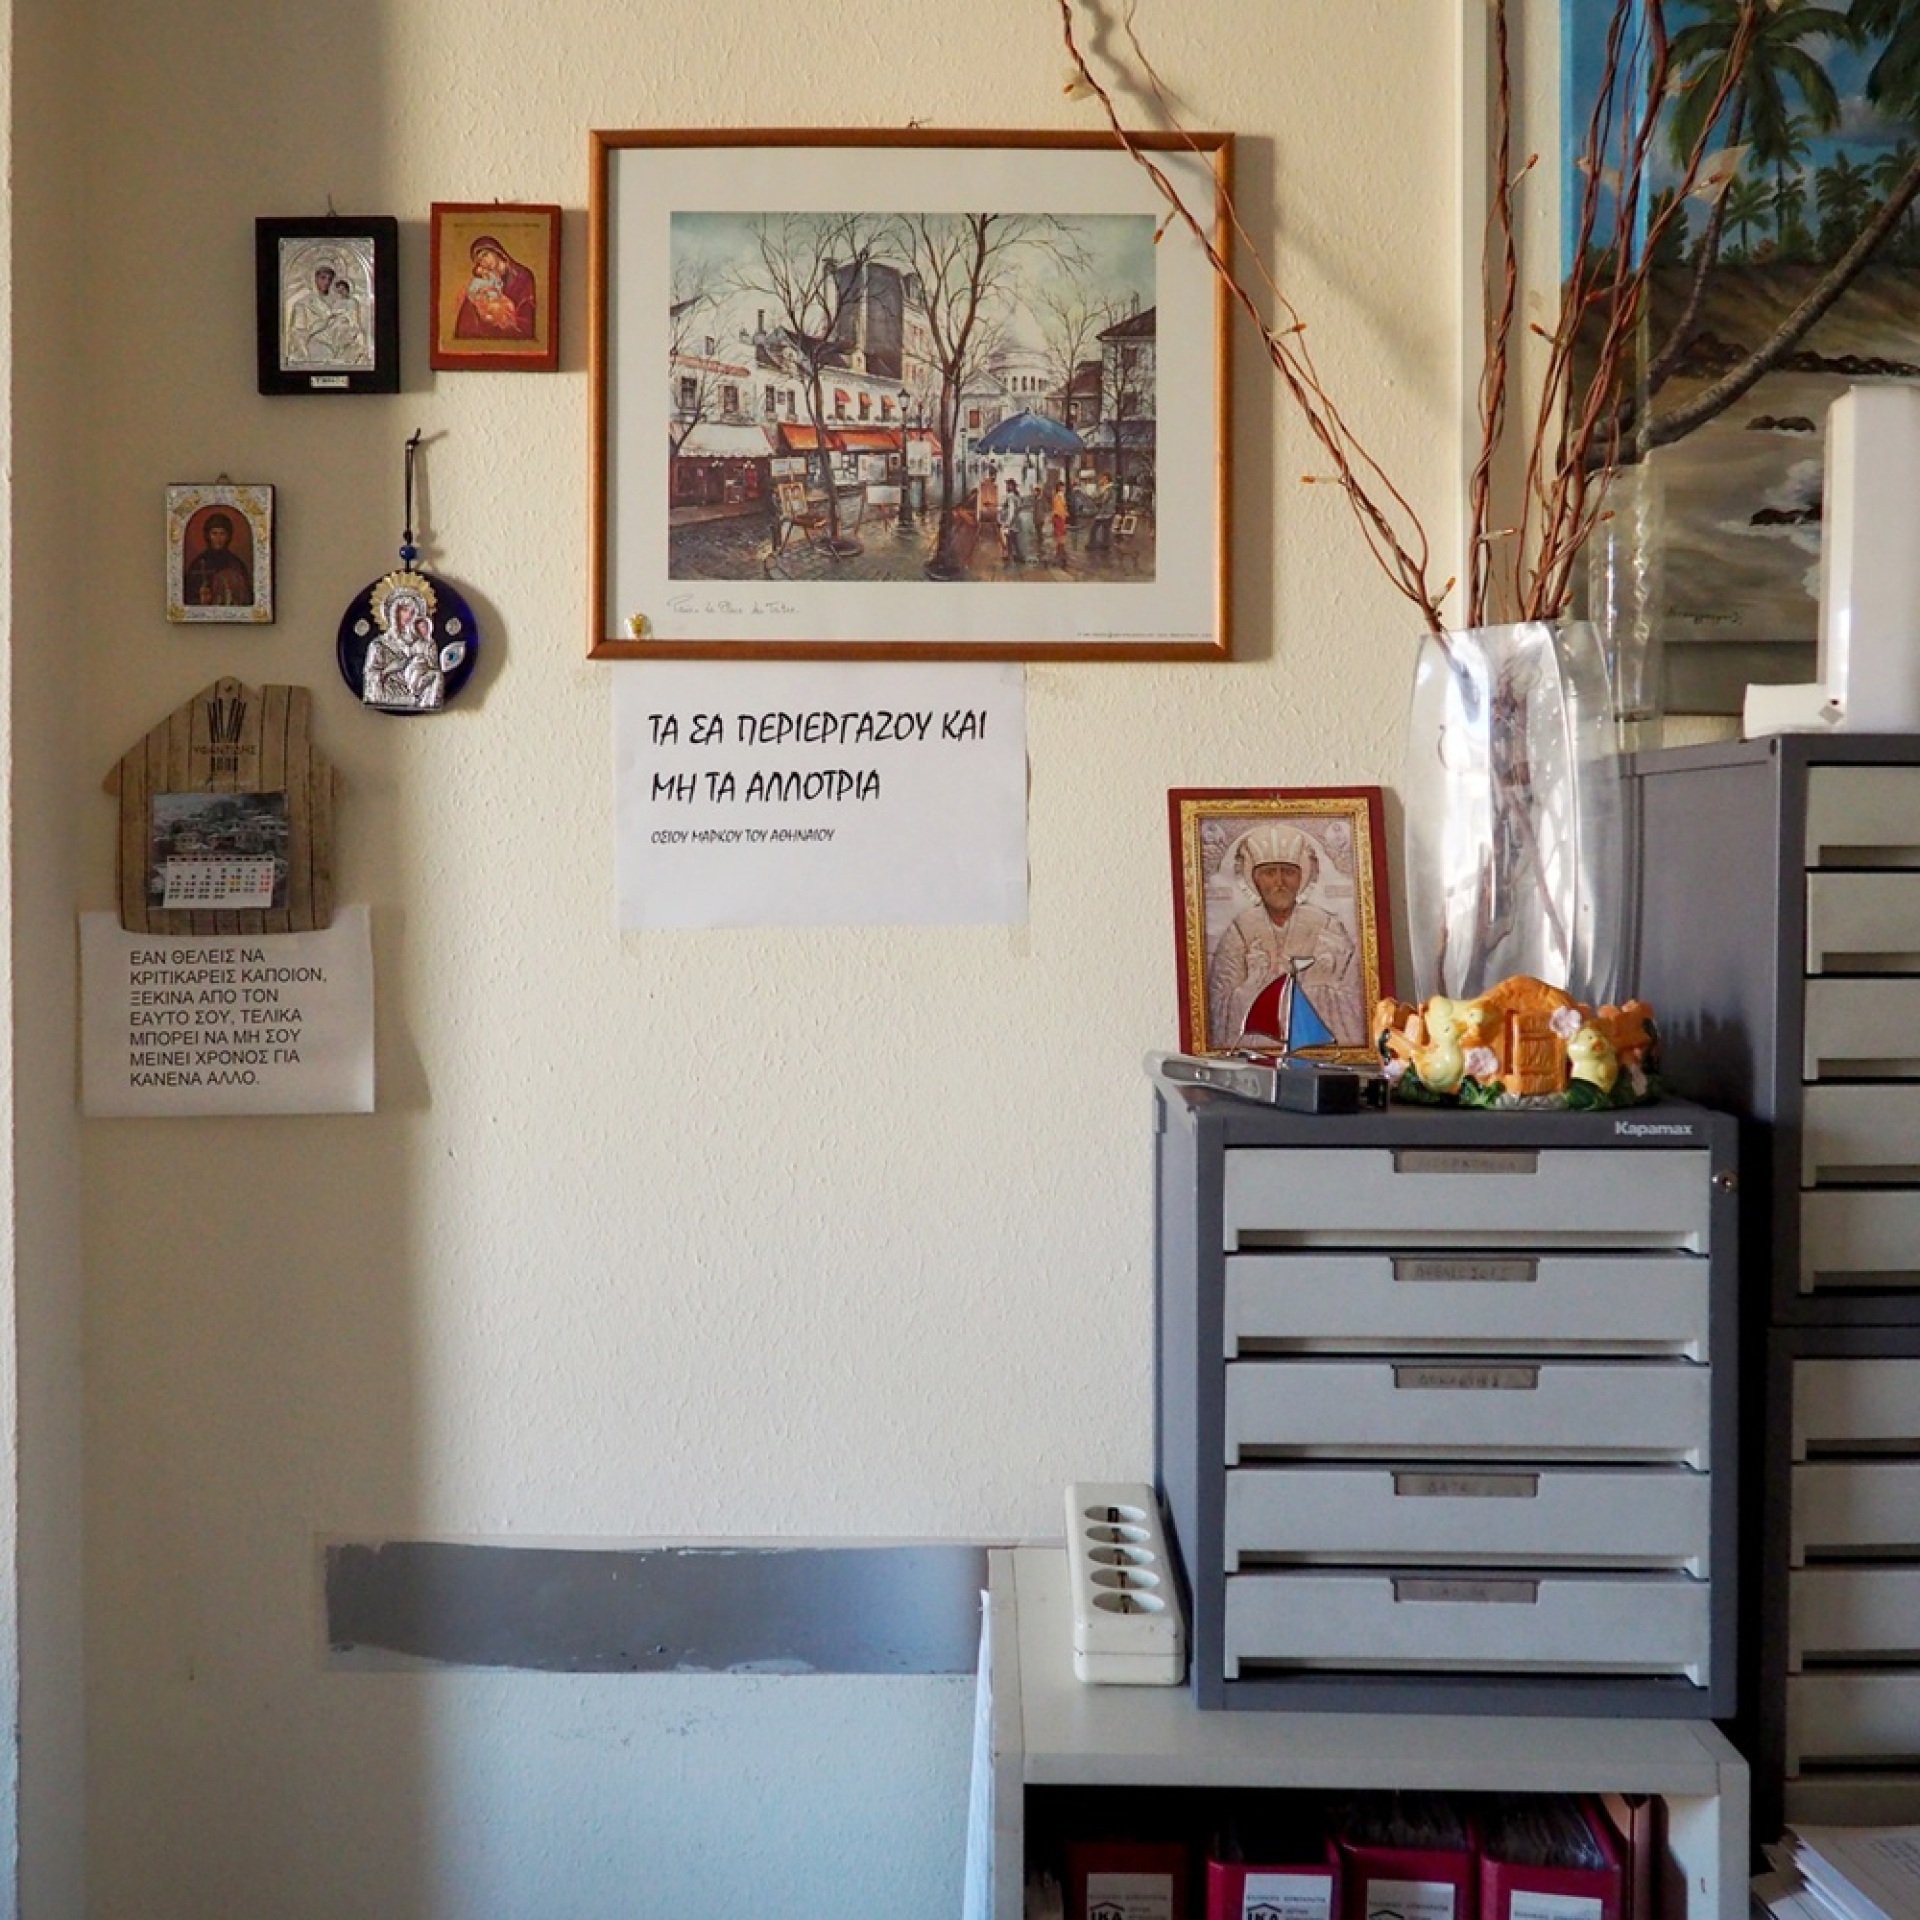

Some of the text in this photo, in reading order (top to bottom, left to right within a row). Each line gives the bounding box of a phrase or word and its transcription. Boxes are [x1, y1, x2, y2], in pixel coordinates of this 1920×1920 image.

[648, 709, 988, 746] ΤΑ ΣΑ ΠΕΡΙΕΡΓΑΖΟΥ ΚΑΙ
[651, 769, 881, 804] ΜΗ ΤΑ ΑΛΛΟΤΡΙΑ
[651, 828, 836, 844] ΟΣΙΟΥ ΜΑΡΚΟΥ ΤΟΥ ΑΘΗΝΑΙΟΥ
[130, 947, 266, 966] ΕΑΝ ΘΕΛΕΙΣ ΝΑ
[130, 969, 237, 986] ΚΡΙΤΙΚΑΡΕΙΣ
[130, 988, 279, 1006] ΞΕΚΙΝΑ ΑΠΟ ΤΟΝ
[130, 1008, 303, 1026] ΕΑΥΤΟ ΣΟΥ, ΤΕΛΙΚΑ
[130, 1028, 302, 1046] ΜΠΟΡΕΙ ΝΑ ΜΗ ΣΟΥ
[130, 1048, 301, 1067] ΜΕΙΝΕΙ ΧΡΟΝΟΣ ΓΙΑ
[130, 1070, 260, 1087] ΚΑΝΕΝΑ ΑΛΛΟ.
[1615, 1120, 1693, 1138] Kapamax
